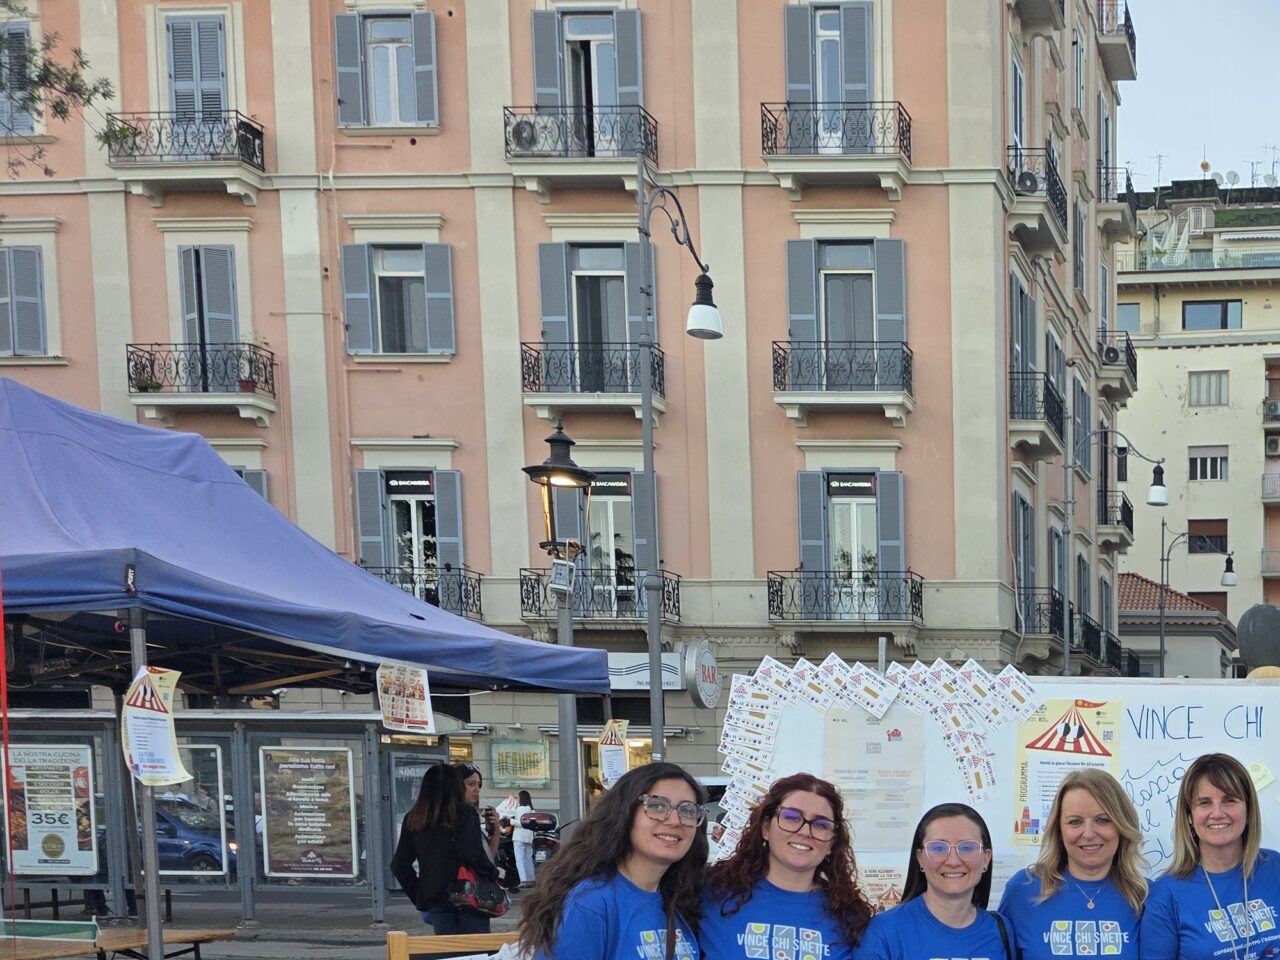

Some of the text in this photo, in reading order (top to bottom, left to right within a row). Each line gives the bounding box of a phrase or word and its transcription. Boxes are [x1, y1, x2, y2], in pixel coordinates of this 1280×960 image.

[702, 665, 716, 684] BAR
[1127, 705, 1203, 740] VINCE
[1224, 706, 1263, 739] CHI
[1020, 762, 1028, 802] PROGRAMMA
[32, 814, 69, 824] 35€
[737, 934, 831, 956] VINCE CHI SMETTE
[1043, 932, 1129, 943] VINCE CHI SMETTE
